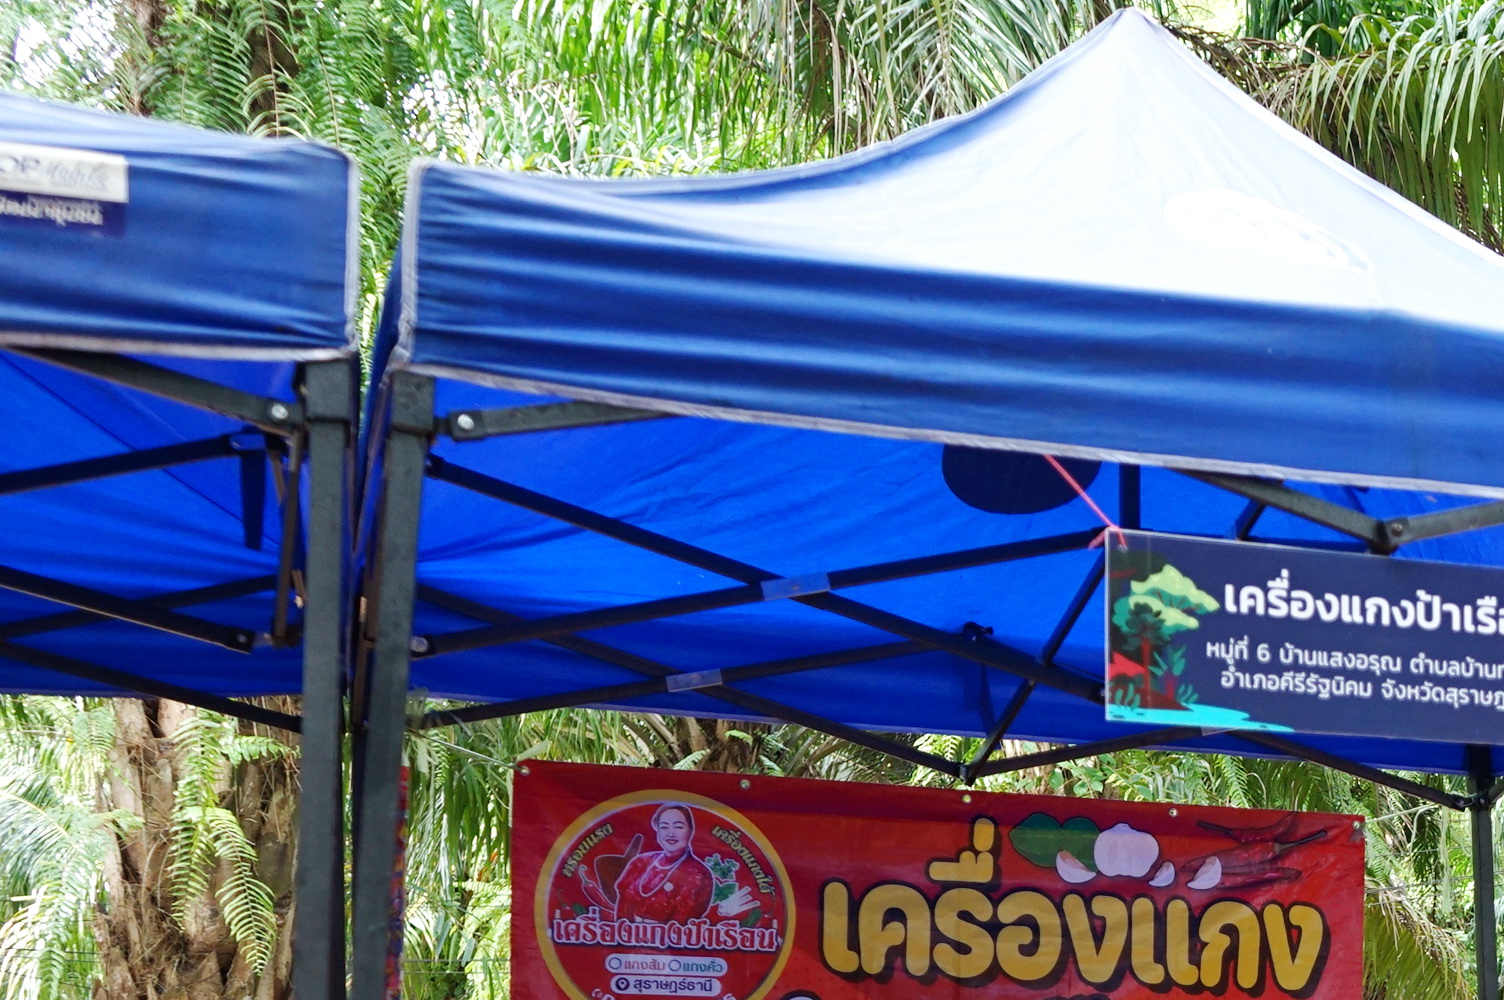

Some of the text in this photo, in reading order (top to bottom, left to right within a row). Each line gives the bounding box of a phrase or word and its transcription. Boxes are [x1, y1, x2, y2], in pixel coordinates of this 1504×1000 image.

[1206, 634, 1249, 665] หมู่ที่
[1256, 643, 1271, 662] 6
[1279, 643, 1401, 676] บ้านแสงอรุณ
[1220, 667, 1373, 699] อำเภอคีรีรัฐนิคม
[822, 817, 1324, 992] เครื่องแกง
[553, 907, 778, 951] เครื่องแกงป้าเรือน
[624, 958, 723, 974] แกงส้ม แกงคั่ว
[633, 977, 713, 994] สุราษฎร์ธานี
